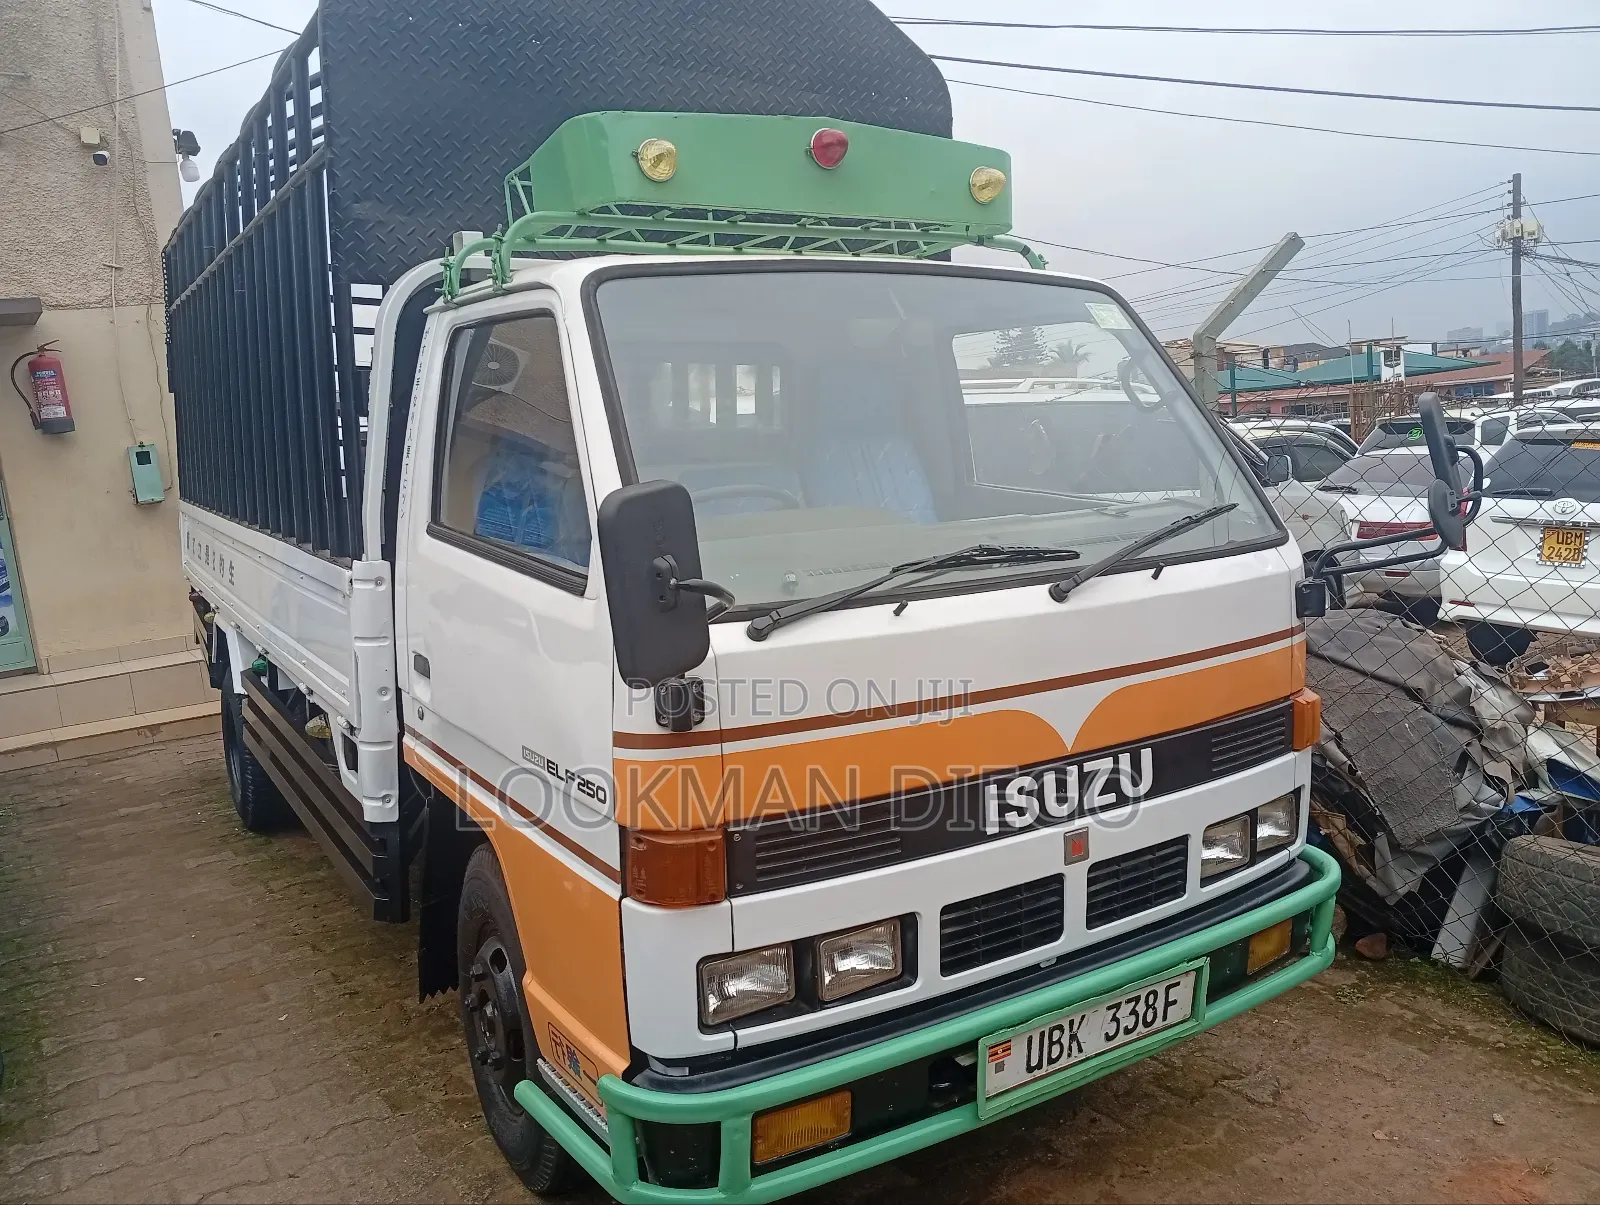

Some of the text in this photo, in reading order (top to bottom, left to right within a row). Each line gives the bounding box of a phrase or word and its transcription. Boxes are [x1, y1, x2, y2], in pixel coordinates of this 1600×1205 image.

[1556, 530, 1583, 547] UBM
[522, 747, 608, 805] ISUZU ELF 250
[984, 747, 1153, 836] ISUZU
[1025, 980, 1181, 1074] UBK 338F
